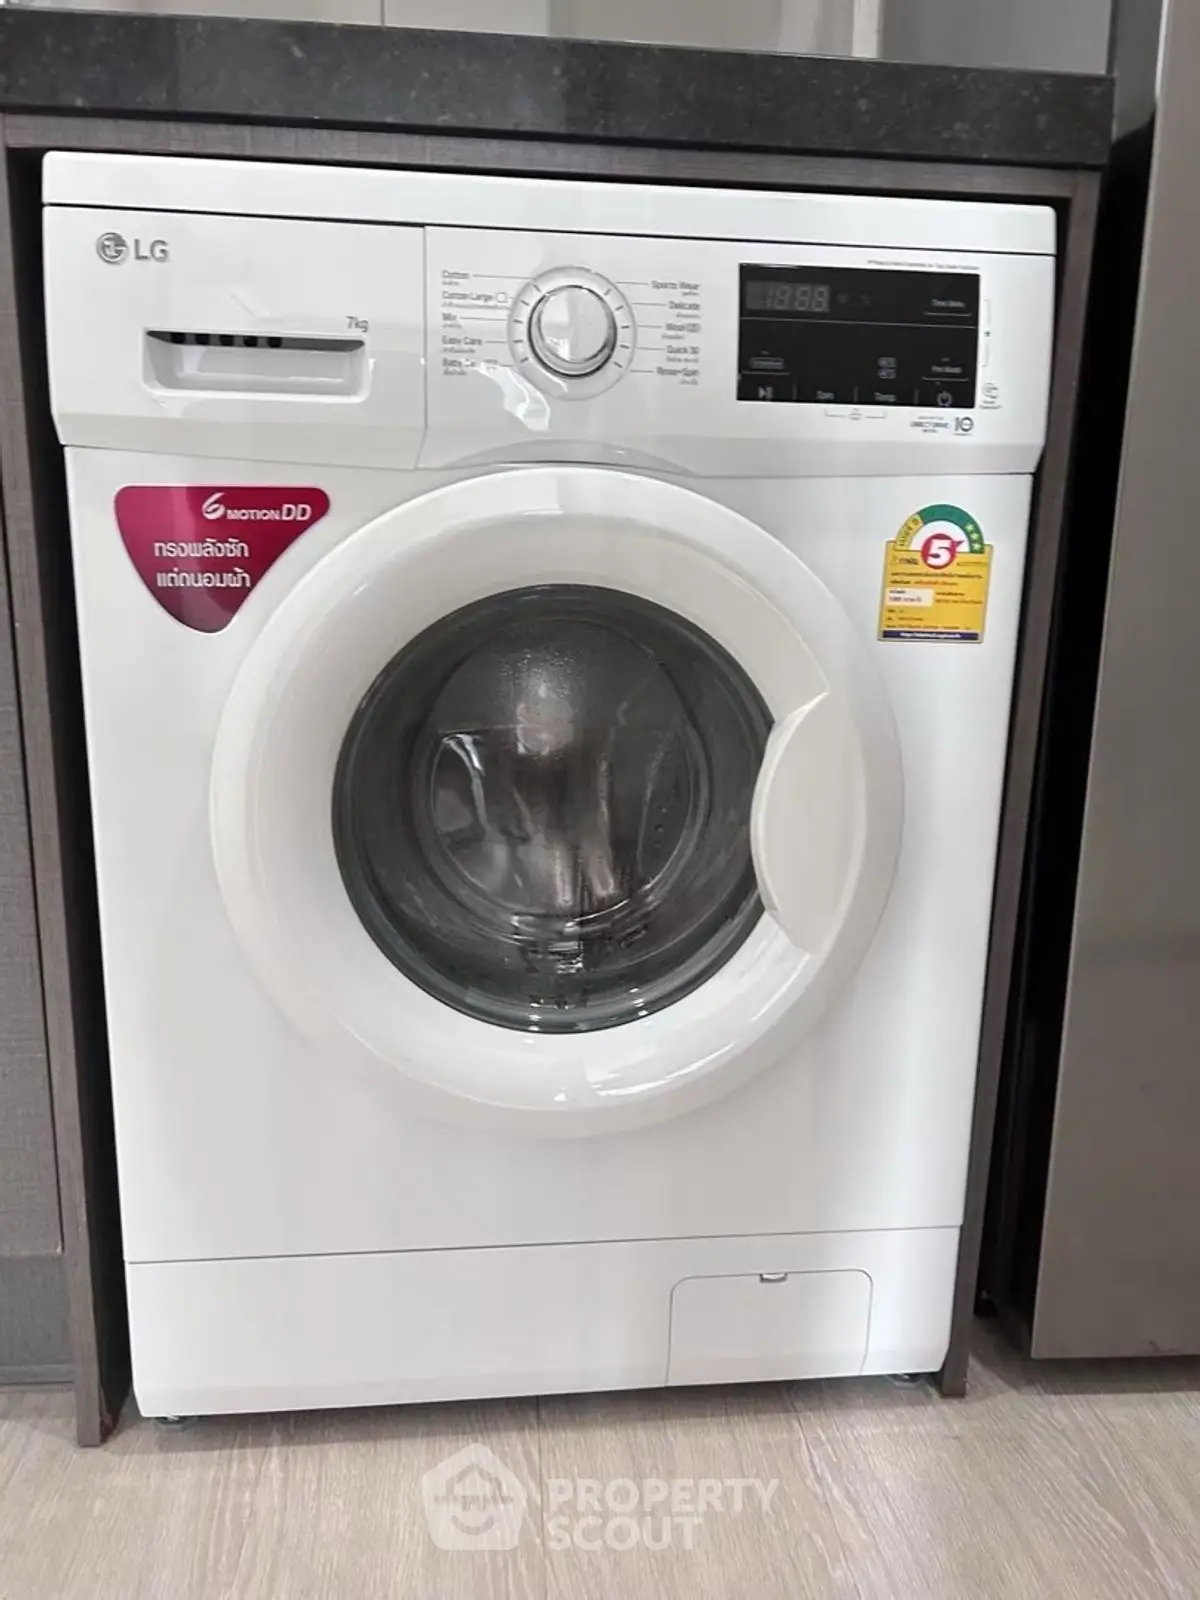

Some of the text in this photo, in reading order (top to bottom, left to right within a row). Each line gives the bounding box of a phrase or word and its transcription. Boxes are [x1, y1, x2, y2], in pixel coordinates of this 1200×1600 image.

[134, 240, 169, 262] LG
[346, 316, 369, 332] 7kg
[202, 492, 312, 521] 6 MOTION DD
[154, 537, 250, 559] ทรงพลังซัก
[926, 537, 953, 566] 5
[157, 567, 251, 589] แต่ถนอมผ้า
